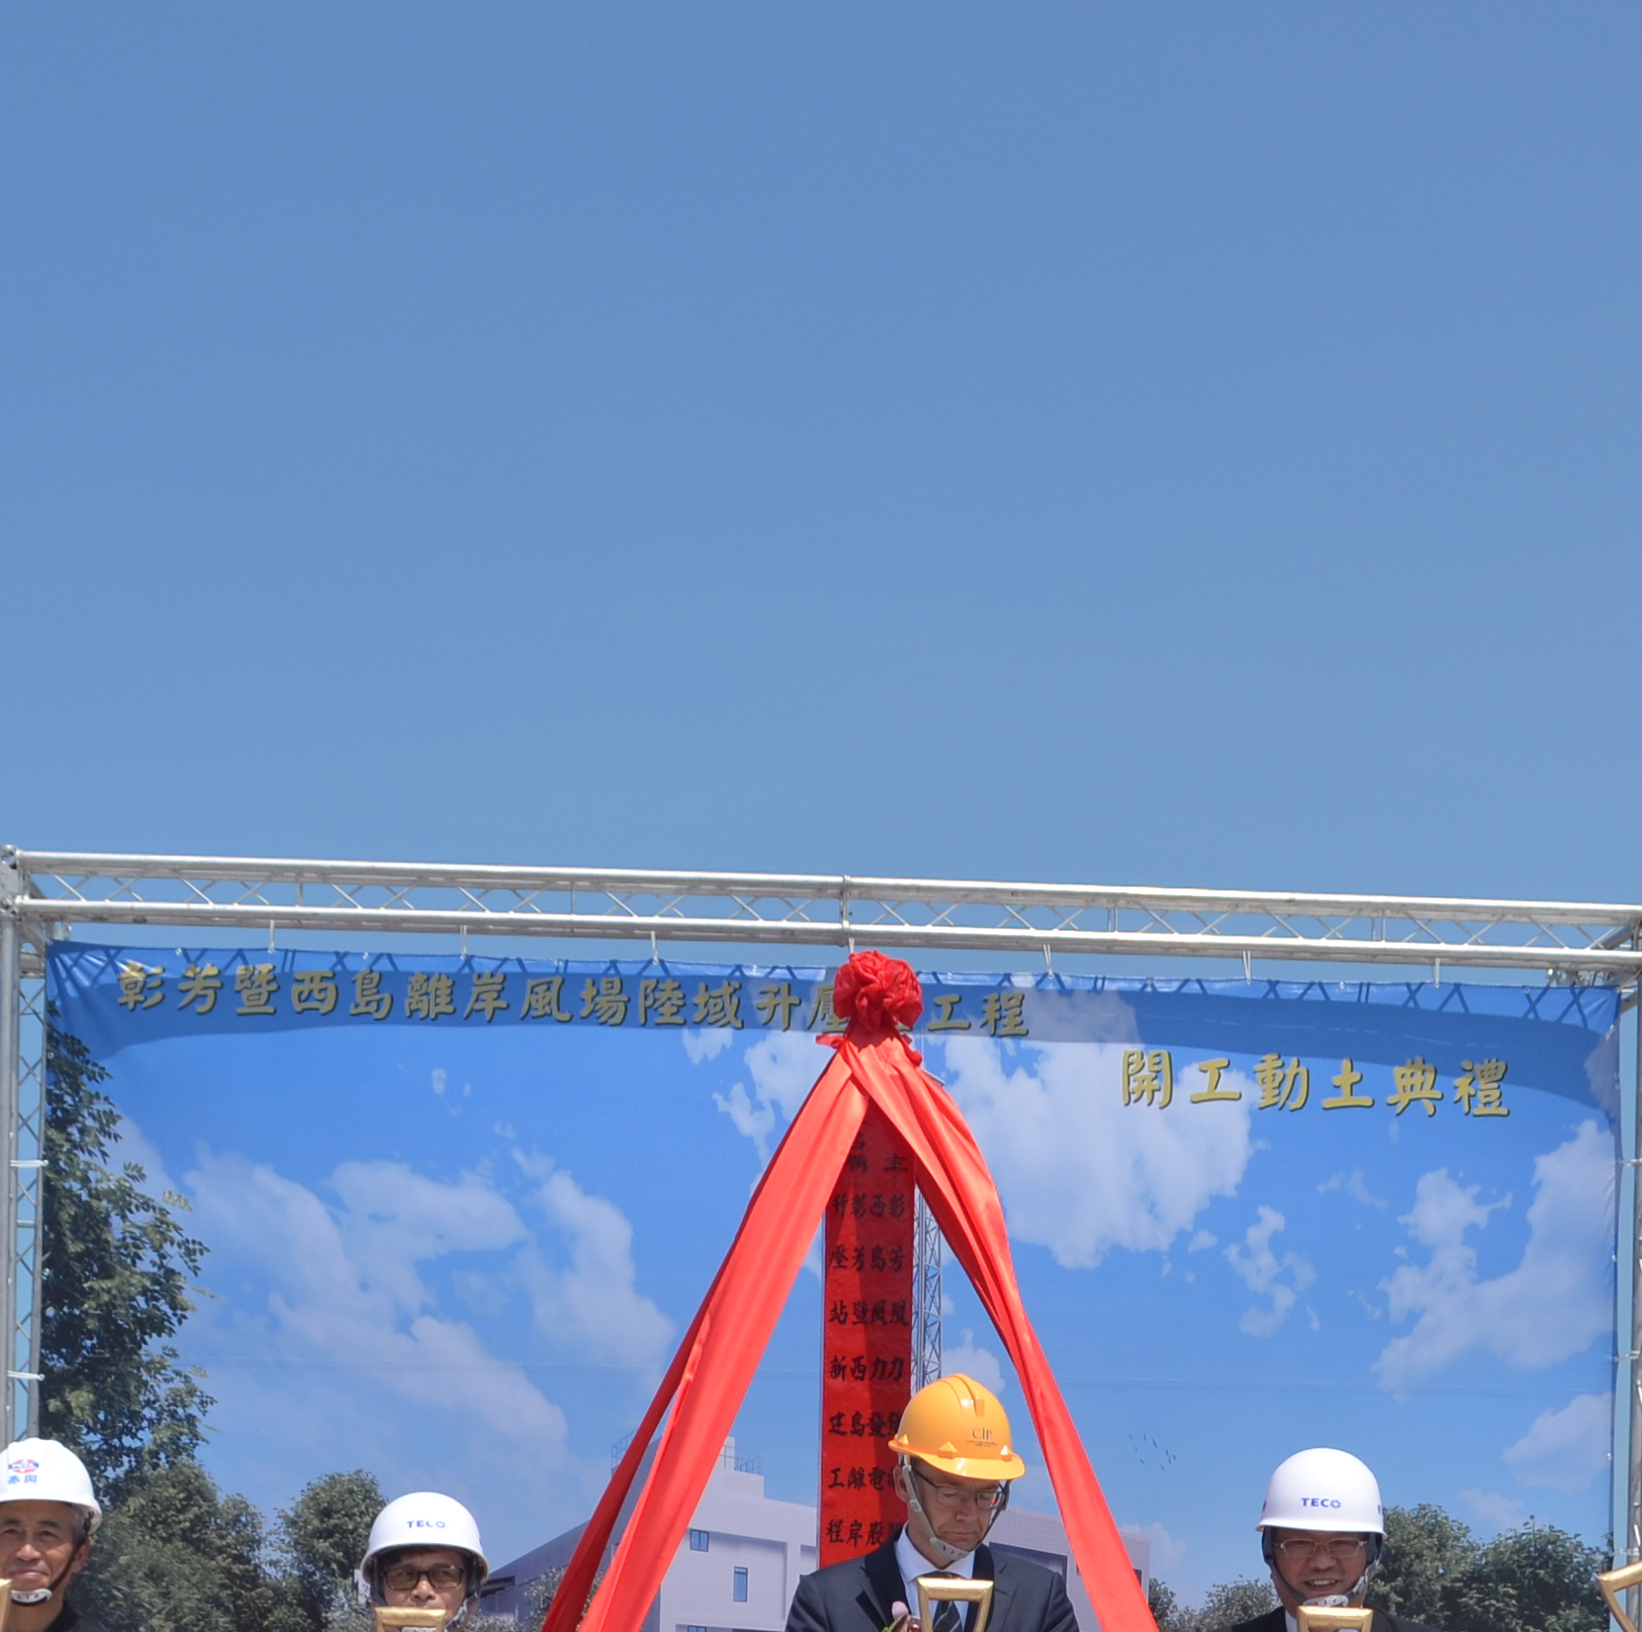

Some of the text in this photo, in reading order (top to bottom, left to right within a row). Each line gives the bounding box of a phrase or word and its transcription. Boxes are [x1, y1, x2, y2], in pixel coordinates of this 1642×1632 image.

[117, 958, 1029, 1037] 彰芳暨西島離岸風場陸域升壓工程
[1121, 1048, 1510, 1117] 開工動土典禮
[1300, 1497, 1342, 1509] TECO
